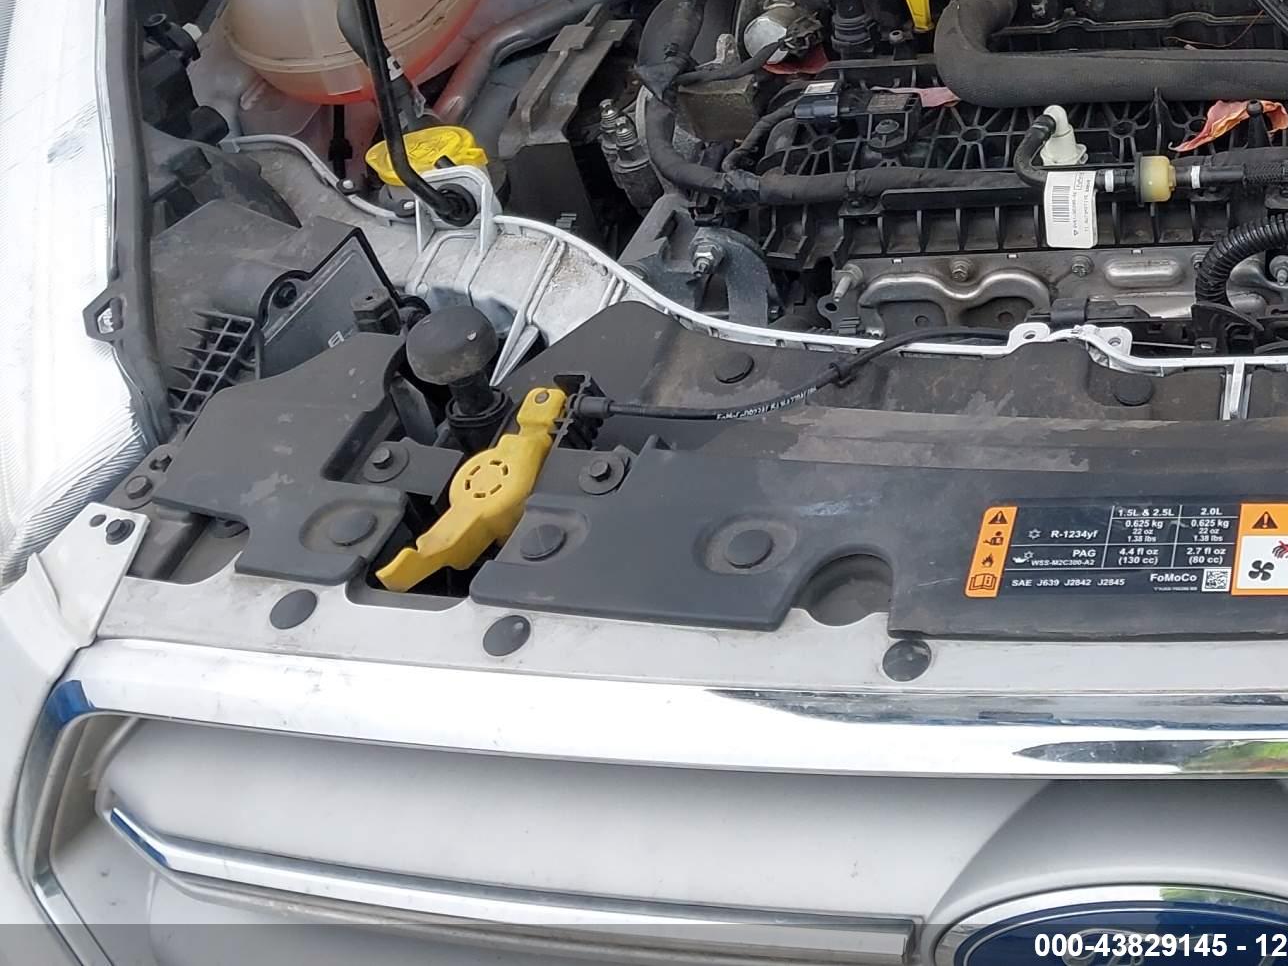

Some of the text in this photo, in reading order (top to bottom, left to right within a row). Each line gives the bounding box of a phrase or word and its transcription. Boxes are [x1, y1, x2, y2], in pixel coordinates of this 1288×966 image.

[1153, 508, 1174, 516] 2.5L
[1200, 507, 1223, 515] 2.0L
[1151, 520, 1164, 529] kg
[1191, 519, 1230, 528] 0.625 kg
[1050, 529, 1098, 540] R-1234yf
[1072, 549, 1096, 557] PAG
[1118, 556, 1158, 565] (130 cc)
[1188, 556, 1223, 565] (80 cc)
[1150, 573, 1197, 582] FoMoCo
